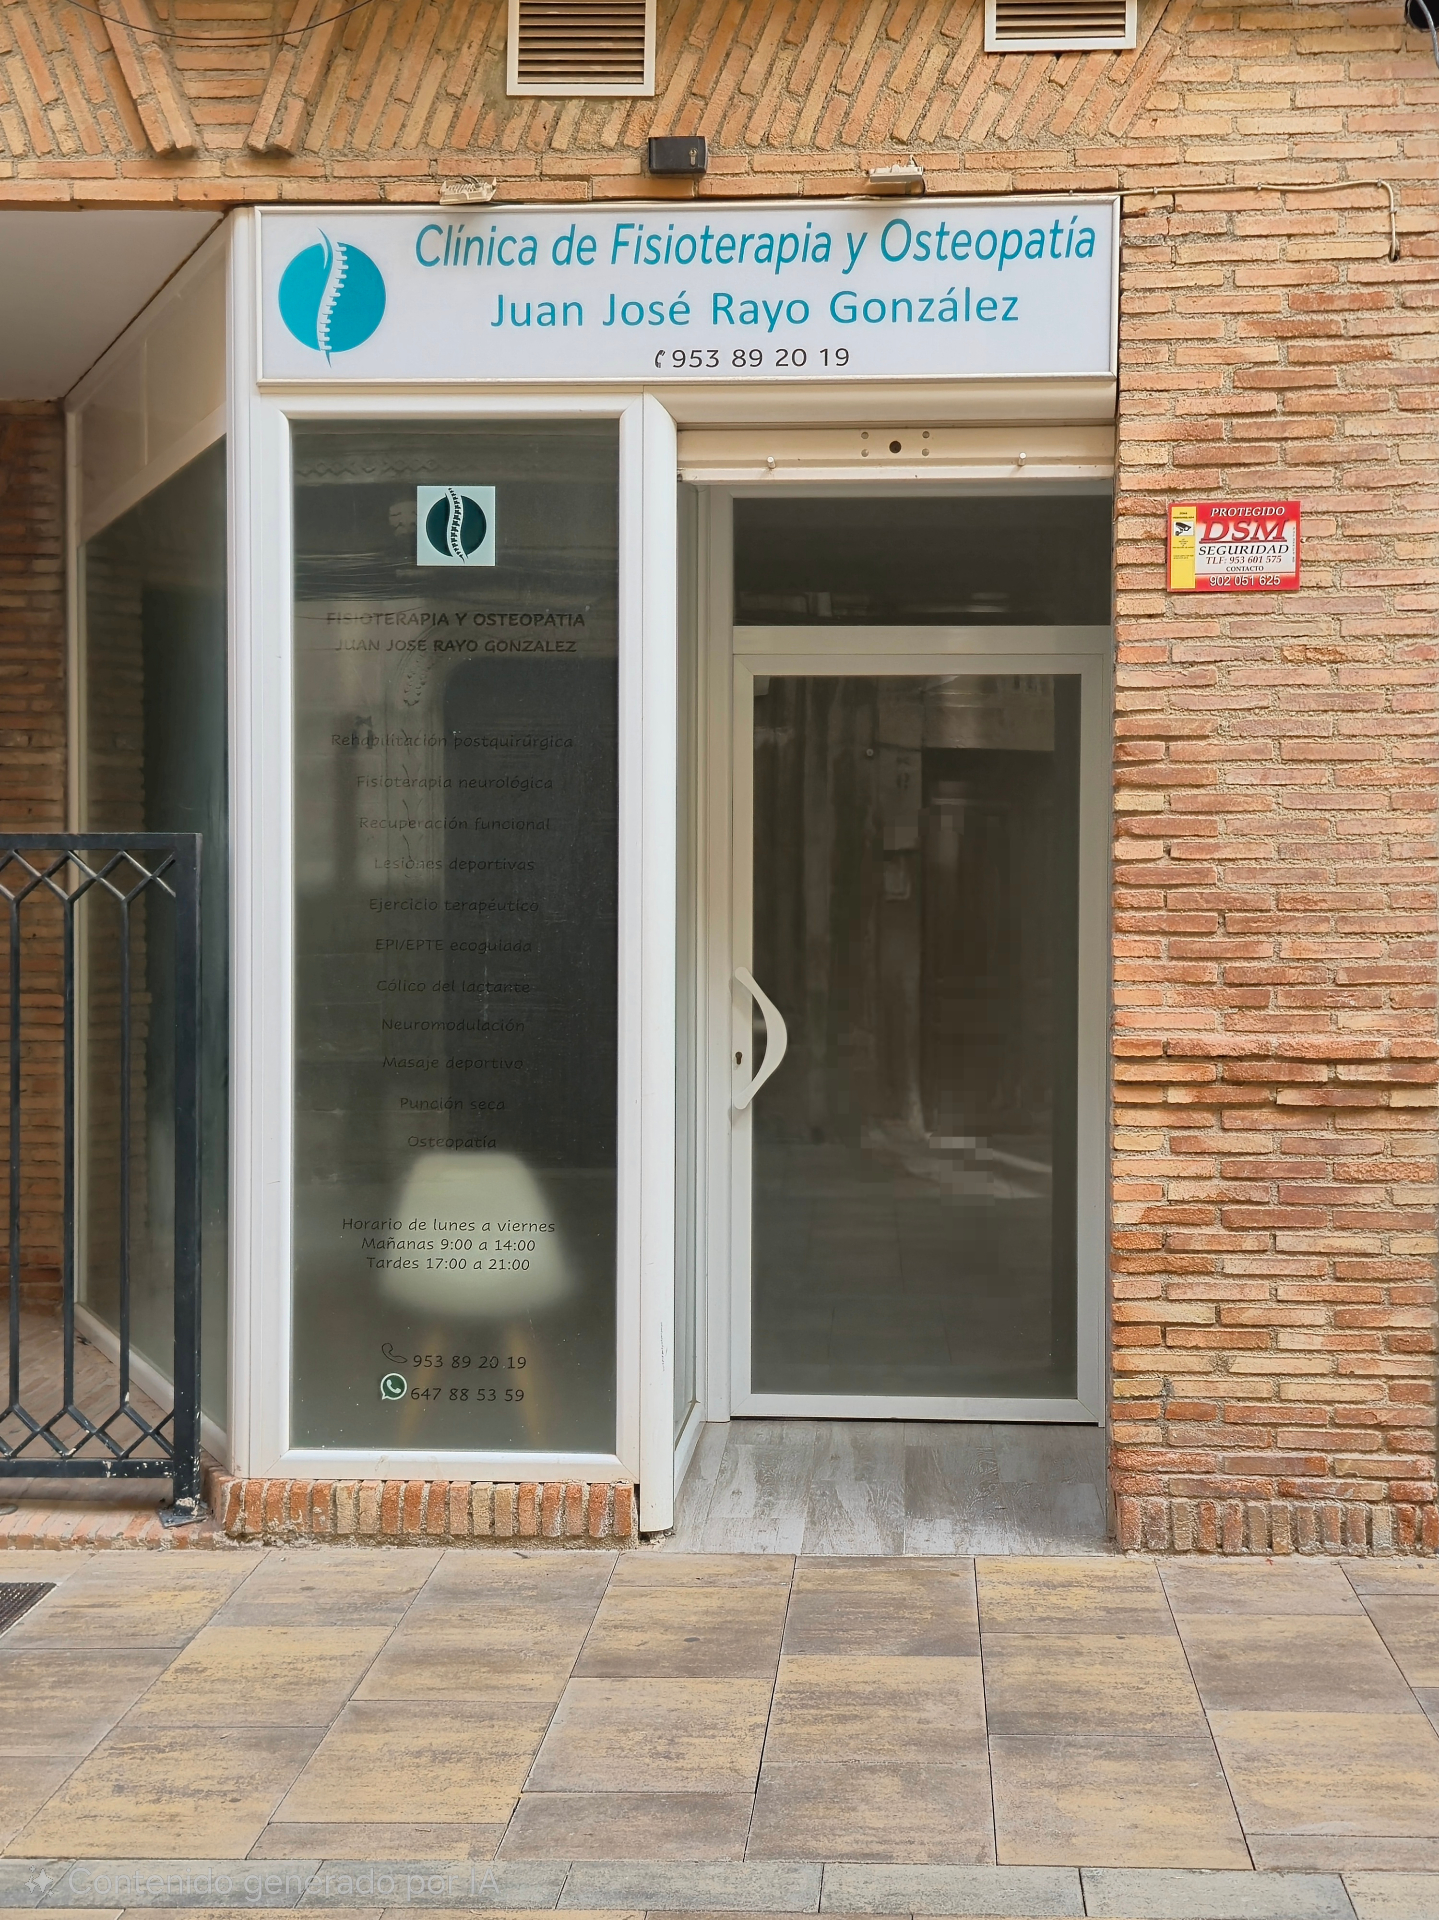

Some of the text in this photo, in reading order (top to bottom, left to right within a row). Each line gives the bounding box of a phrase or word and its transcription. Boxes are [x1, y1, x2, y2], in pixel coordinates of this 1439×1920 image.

[415, 216, 1097, 275] Clínica de Fisioterapia y Osteopatía
[490, 286, 1019, 334] Juan José Rayo González
[672, 348, 850, 369] 953 89 20 19
[1210, 506, 1286, 517] PROTEGIDO
[1199, 519, 1290, 543] DSM
[1198, 544, 1289, 556] SEGURIDAD
[1229, 555, 1245, 564] 953
[1247, 555, 1263, 564] 601
[1266, 555, 1282, 564] 575
[1226, 565, 1264, 573] CONTACTO
[1210, 575, 1281, 587] 902 051 625
[327, 612, 585, 627] FISIOTERAPIA Y OSTEOPATIA
[334, 639, 577, 653] JUAN JOSE RAYO GONZALEZ
[331, 734, 573, 750] Rehabilitación postquirúrgica
[357, 776, 553, 791] Fisioterapia neurológica
[359, 817, 550, 833] Recuperación funcional
[374, 858, 535, 873] Lesiones deportivas
[369, 898, 539, 914] Ejercicio terapéutico
[376, 939, 532, 954] EPI/EPTE ecoguiada
[376, 979, 531, 992] Cólico del lactante
[382, 1019, 525, 1032] Neuromodulación
[382, 1057, 524, 1071] Masaje deportivo
[400, 1097, 505, 1110] Punción seca
[408, 1136, 497, 1151] Osteopatía
[342, 1218, 556, 1233] Horario de lunes a viernes
[361, 1237, 536, 1252] Mañanas 9:00 a 14:00
[366, 1257, 530, 1271] Tardes 17:00 a 21:00
[413, 1355, 527, 1369] 953 89 20 19
[410, 1388, 525, 1402] 647 88 53 59
